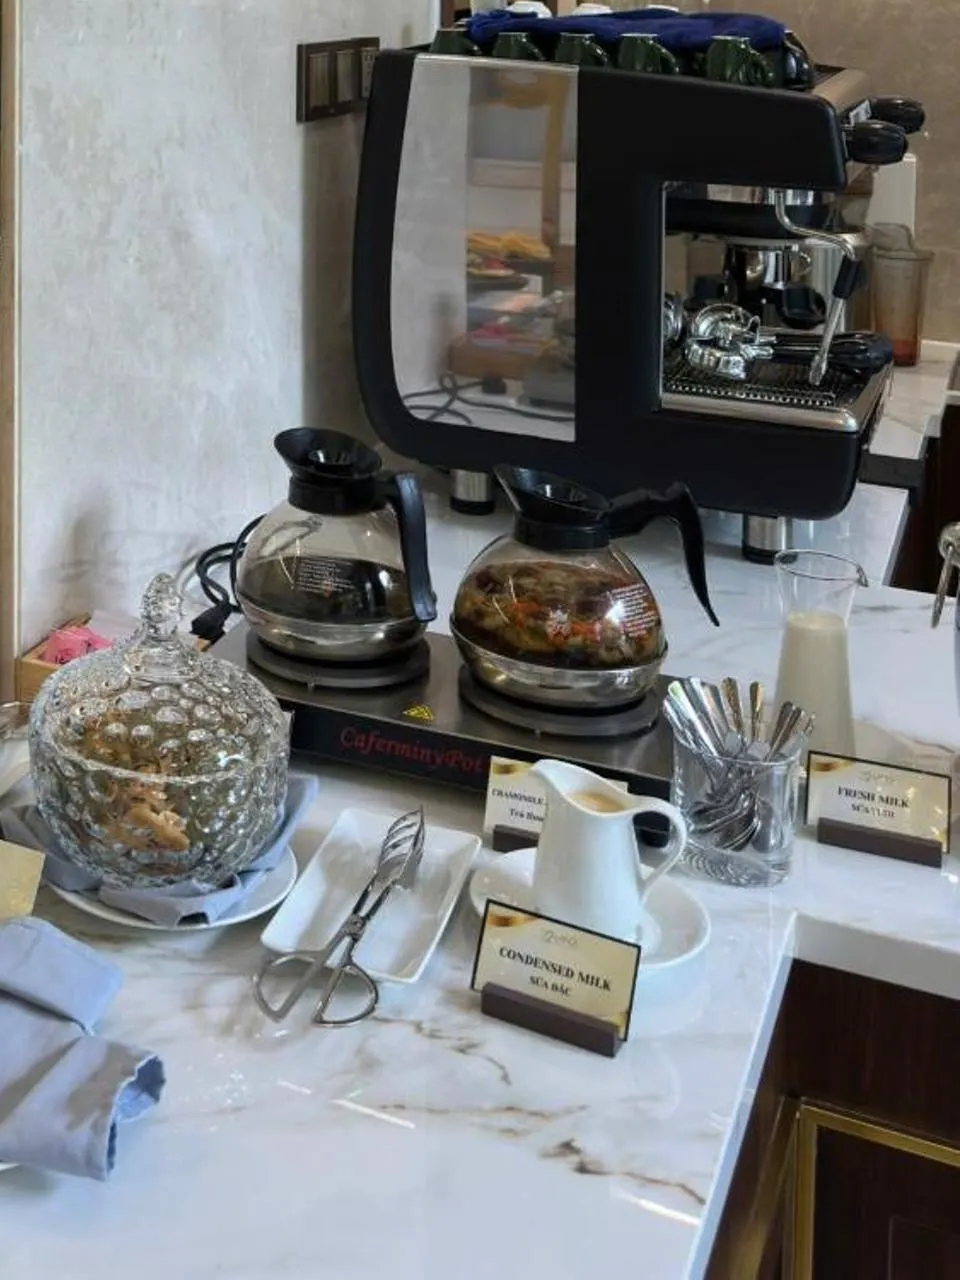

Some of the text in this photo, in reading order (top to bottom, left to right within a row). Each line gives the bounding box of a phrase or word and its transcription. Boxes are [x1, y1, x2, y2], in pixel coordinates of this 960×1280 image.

[837, 785, 910, 809] FRESH MILK
[499, 946, 612, 992] CONDENSED MILK
